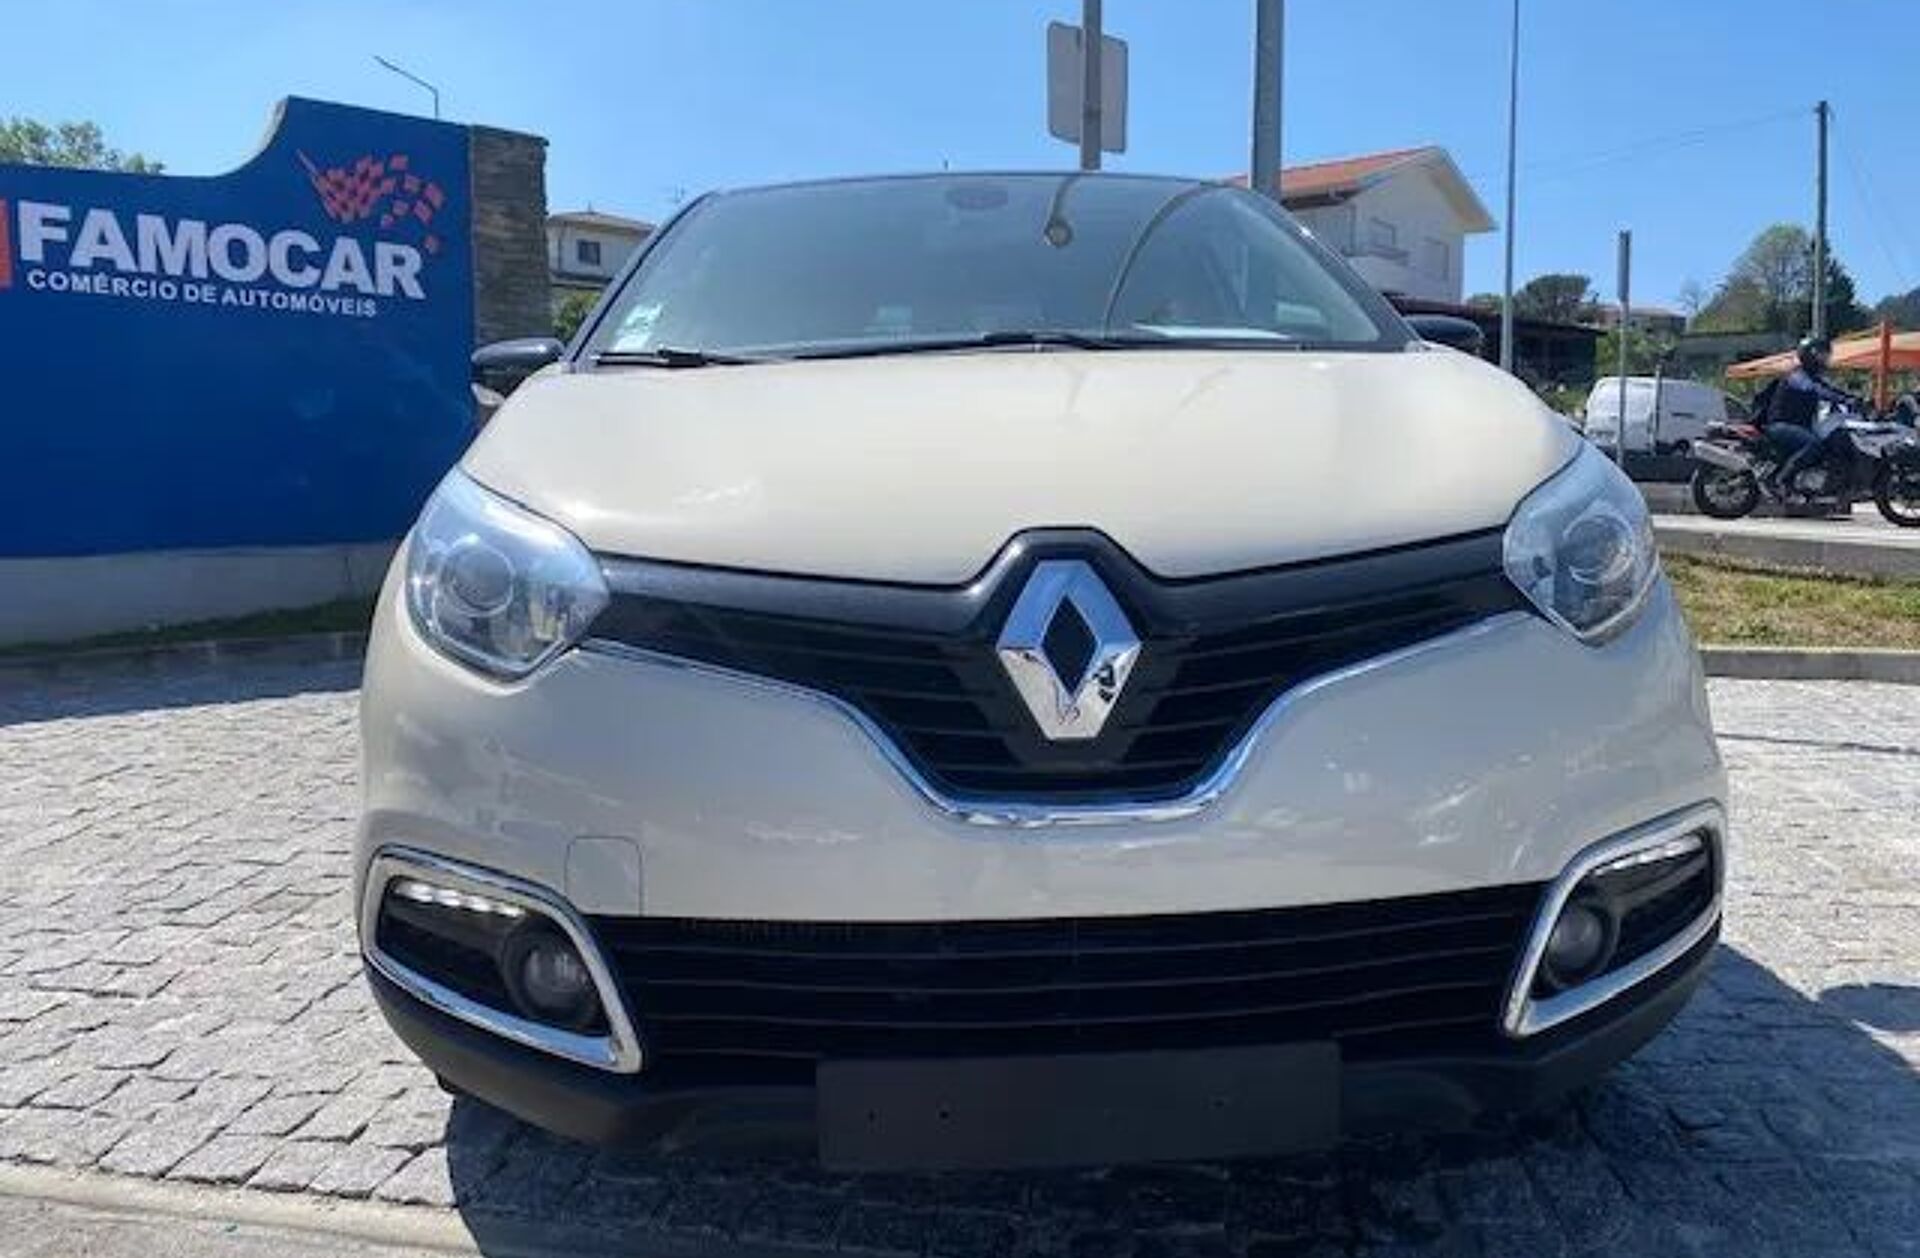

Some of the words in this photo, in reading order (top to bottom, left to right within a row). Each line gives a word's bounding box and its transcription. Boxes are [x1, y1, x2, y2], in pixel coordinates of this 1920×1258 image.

[19, 200, 425, 299] FAMOCAR
[28, 269, 177, 300] COMÉRCIO
[184, 284, 216, 302] DE
[223, 288, 376, 317] AUTOMÓVEIS
